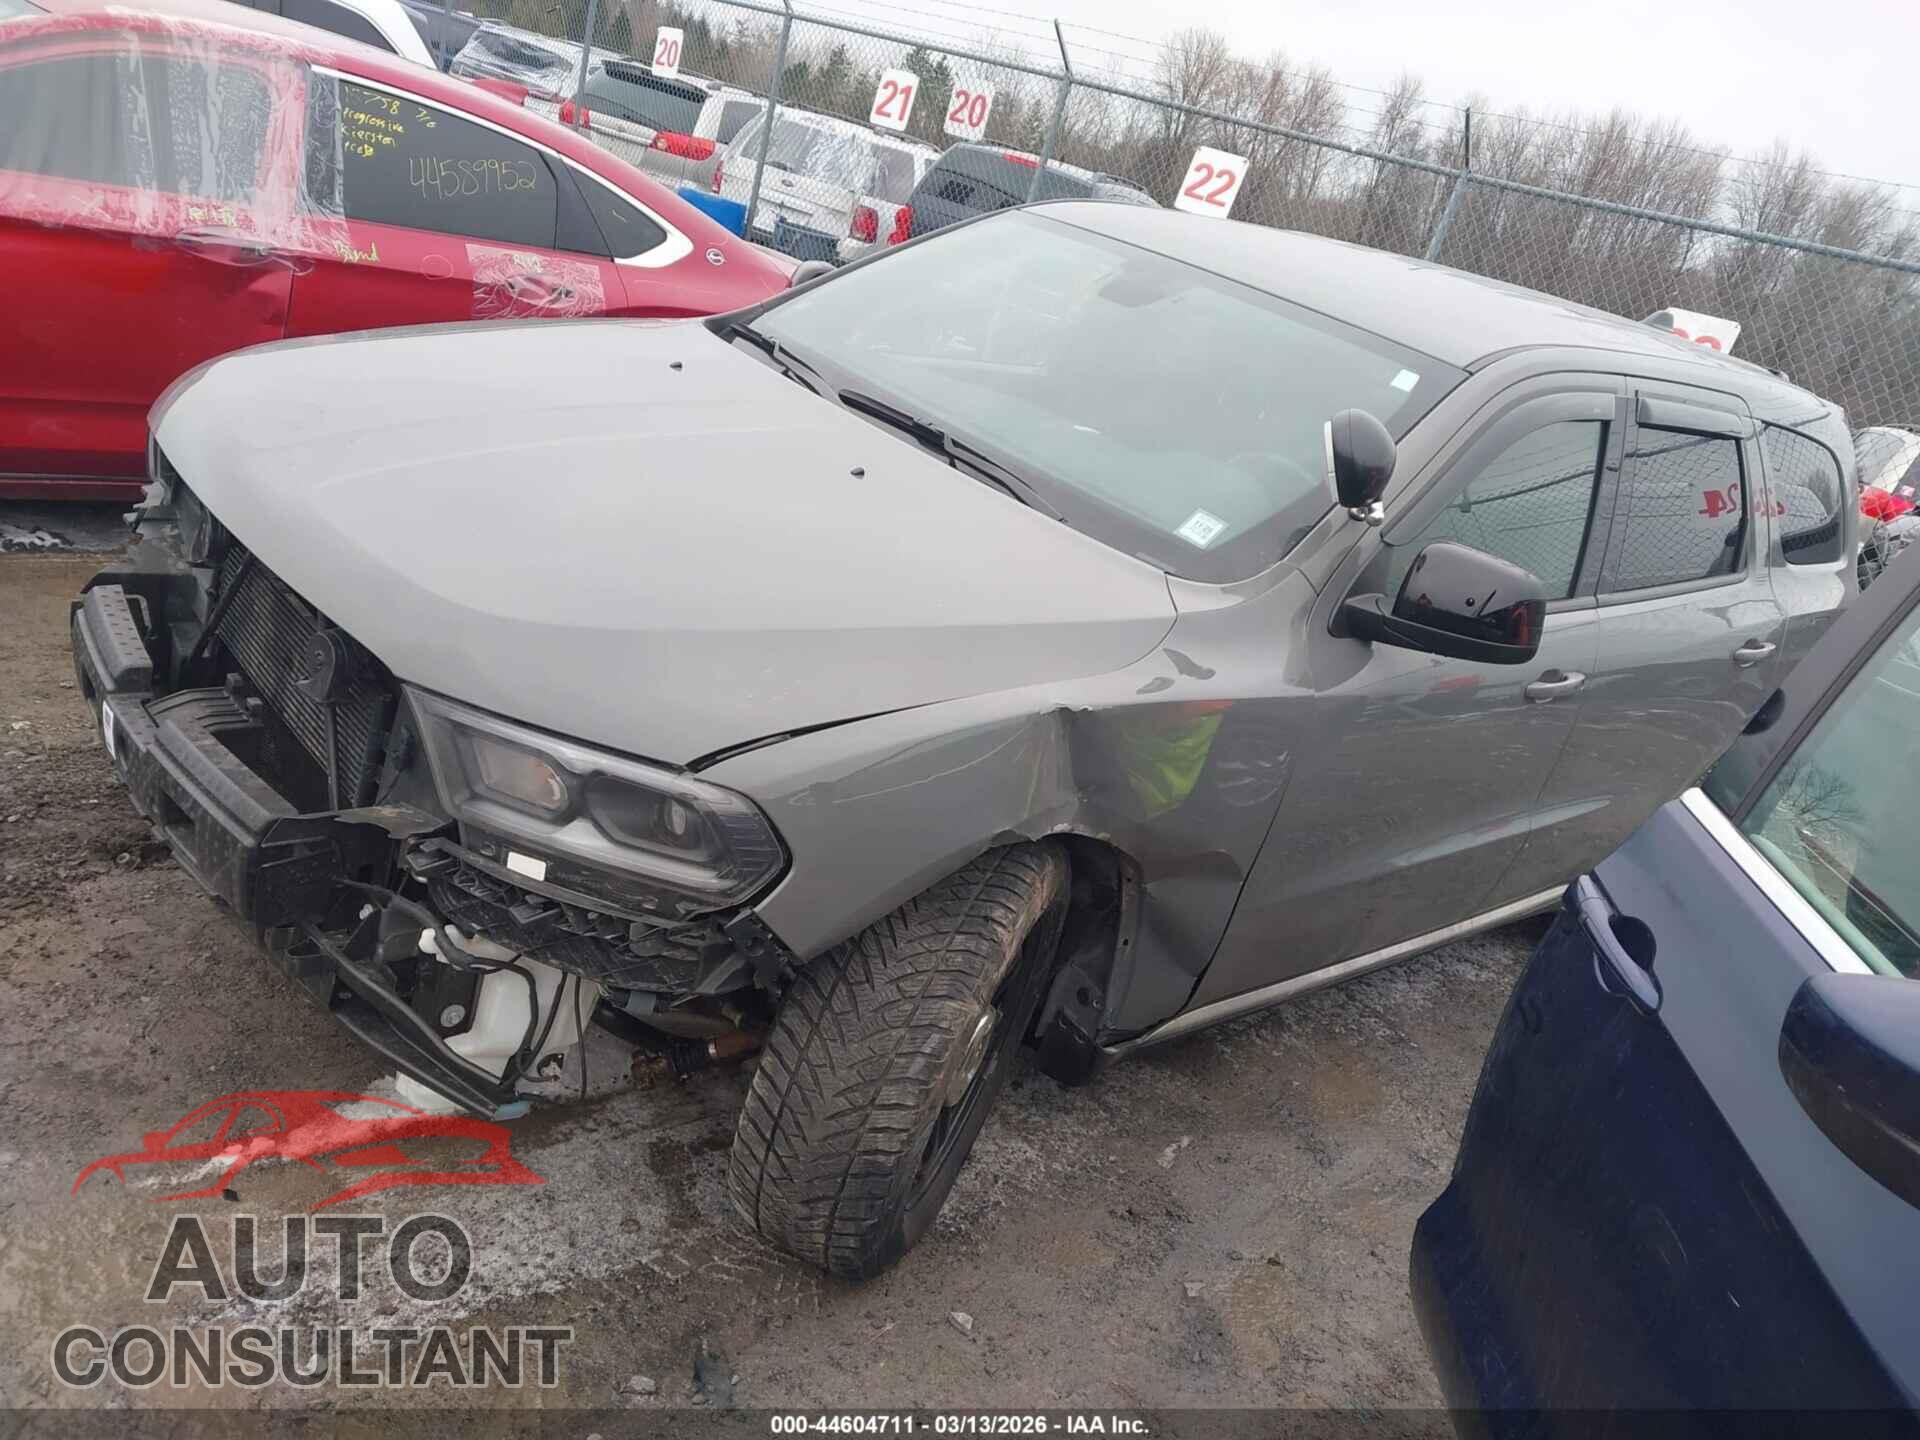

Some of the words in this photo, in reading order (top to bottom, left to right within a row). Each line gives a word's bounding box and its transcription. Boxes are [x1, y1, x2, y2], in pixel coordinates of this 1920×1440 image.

[655, 37, 679, 68] 20
[875, 80, 912, 122] 21
[949, 89, 987, 128] 20
[408, 156, 537, 200] 44589952
[1184, 163, 1236, 207] 22
